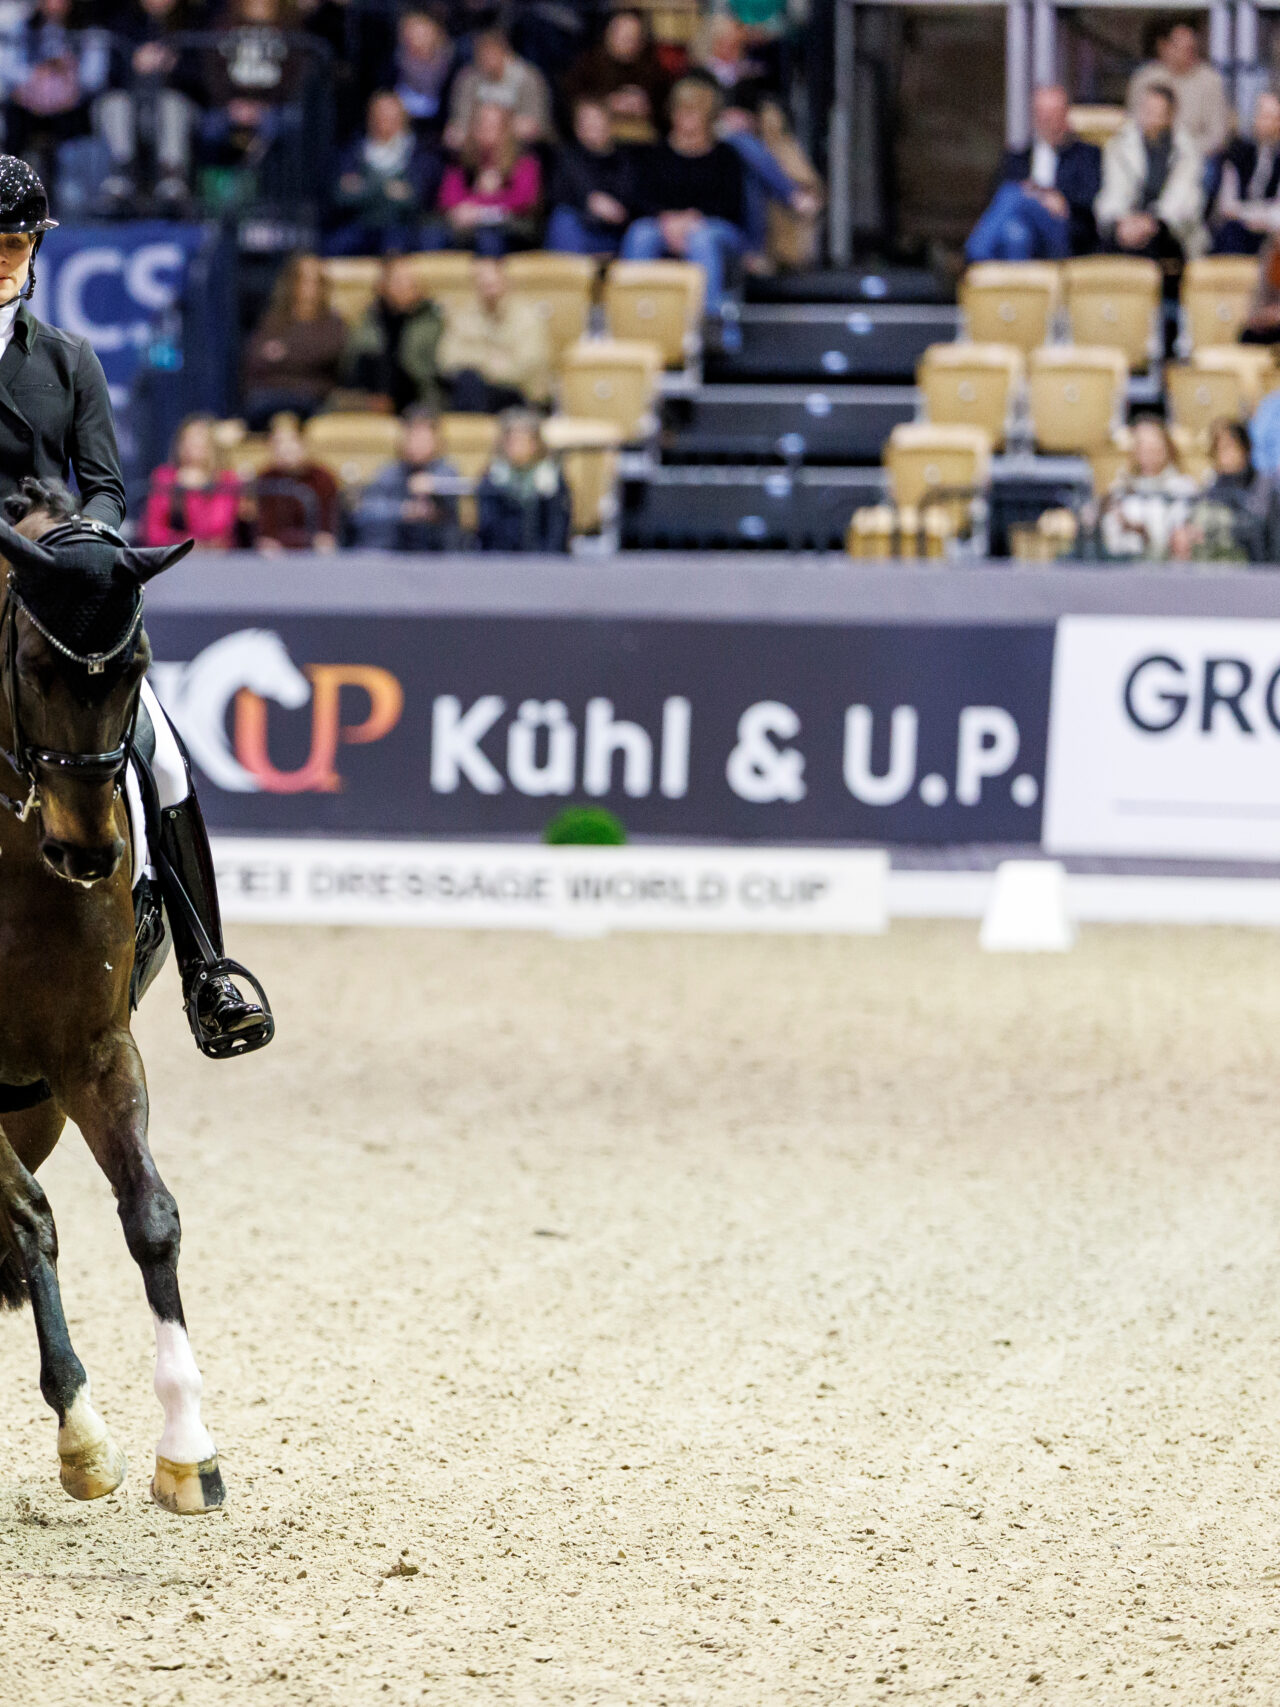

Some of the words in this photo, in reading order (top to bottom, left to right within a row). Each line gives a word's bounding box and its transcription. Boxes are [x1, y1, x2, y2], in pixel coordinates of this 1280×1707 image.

[429, 695, 694, 799] Kühl
[726, 699, 807, 803] &
[842, 702, 1039, 807] U.P.
[308, 863, 553, 905] DRESSAGE
[566, 867, 731, 910] WORLD
